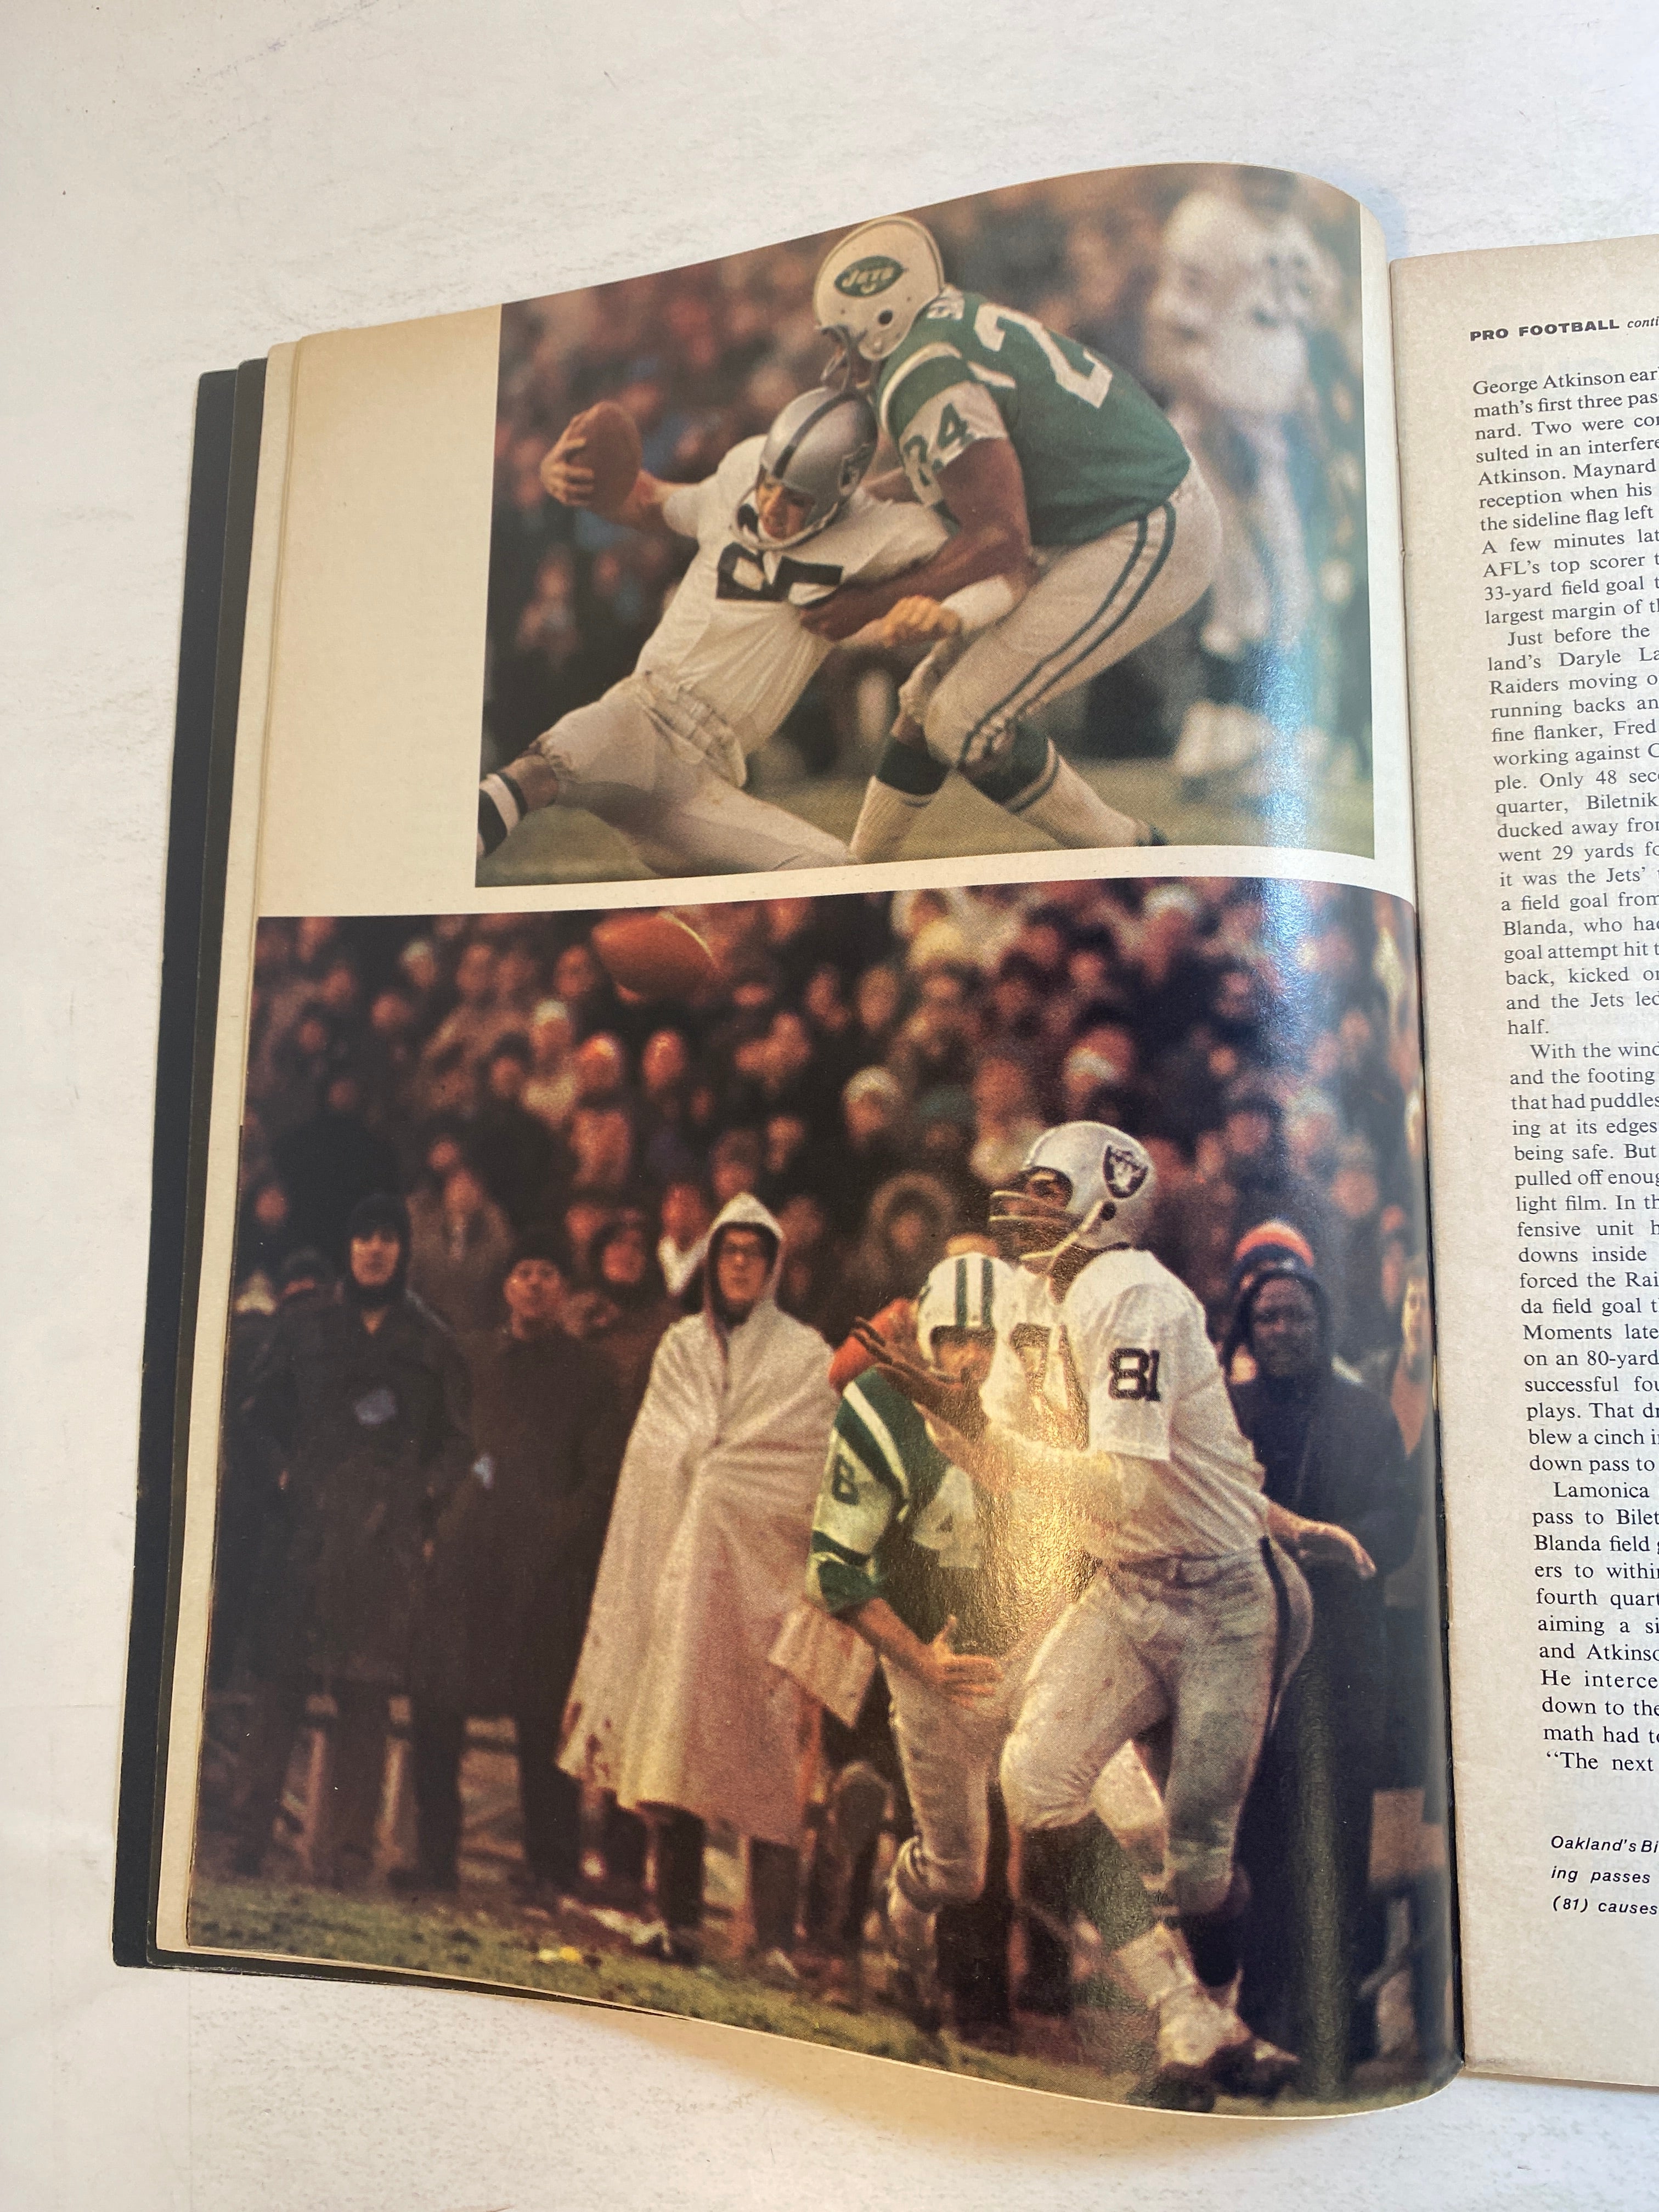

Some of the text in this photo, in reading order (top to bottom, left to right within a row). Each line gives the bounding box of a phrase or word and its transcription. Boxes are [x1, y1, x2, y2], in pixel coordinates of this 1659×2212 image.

[1470, 315, 1659, 342] PRO FOOTBALL conti
[1472, 372, 1626, 395] George Atkinson
[1474, 394, 1623, 418] math's first three
[1474, 419, 1624, 441] nard. Two were
[1476, 444, 1530, 464] sulted
[1536, 443, 1553, 458] in
[1559, 445, 1581, 456] an
[1477, 458, 1657, 486] Atkinson. Maynard
[1479, 482, 1652, 509] reception when his
[1479, 504, 1654, 532] the sideline flag left
[1481, 533, 1625, 555] A few minutes
[1482, 556, 1646, 578] AFL's top scorer
[1484, 575, 1645, 602] 33-yard field goal
[1484, 598, 1644, 626] largest margin of
[1507, 624, 1650, 646] Just before the
[1487, 649, 1622, 672] land's Daryle
[1488, 673, 1638, 695] Raiders moving
[1489, 697, 1626, 719] running backs
[1491, 718, 1657, 743] fine flanker, Fred
[1492, 744, 1641, 766] working against
[1494, 769, 1617, 793] ple. Only 48
[1496, 792, 1659, 817] quarter, Biletnik
[1497, 820, 1619, 838] ducked away
[1498, 842, 1634, 862] went 29 yards
[1499, 866, 1646, 887] it was the Jets'
[1501, 892, 1608, 912] a field goal
[1502, 917, 1623, 936] Blanda, who
[1504, 940, 1649, 964] goal attempt hit
[1504, 966, 1630, 987] back, kicked
[1506, 992, 1624, 1010] and the Jets
[1507, 1019, 1549, 1035] half.
[1529, 1042, 1611, 1060] With the
[1510, 1066, 1655, 1085] and the footing
[1510, 1094, 1548, 1110] that
[1551, 1093, 1587, 1109] had
[1511, 1118, 1657, 1138] ing at its edges
[1513, 1143, 1657, 1164] being safe. But
[1514, 1169, 1604, 1190] pulled off
[1515, 1194, 1637, 1215] light film. In
[1516, 1220, 1634, 1238] fensive unit
[1518, 1245, 1647, 1263] downs inside
[1519, 1271, 1659, 1289] forced the Rai
[1521, 1297, 1642, 1317] da field goal
[1522, 1323, 1659, 1340] Moments late
[1523, 1349, 1659, 1369] on an 80-yard
[1108, 1347, 1161, 1402] 81
[1524, 1375, 1620, 1393] successful
[1526, 1402, 1635, 1422] plays. That
[1527, 1428, 1645, 1445] blew a cinch
[1529, 1454, 1655, 1475] down pass to
[1552, 1481, 1650, 1498] Lamonica
[1531, 1508, 1659, 1528] pass to Bilet
[1532, 1533, 1651, 1553] Blanda field
[1534, 1564, 1594, 1578] ers to
[1536, 1587, 1659, 1610] fourth quart
[1537, 1615, 1631, 1637] aiming a
[1539, 1642, 1576, 1659] and
[1539, 1668, 1658, 1689] He interce
[1542, 1695, 1624, 1716] down to
[1543, 1724, 1640, 1744] math had
[1611, 1757, 1654, 1772] next
[1550, 1835, 1637, 1853] Oakland's
[1550, 1865, 1651, 1884] ing passes
[1553, 1895, 1658, 1916] (81) causes
